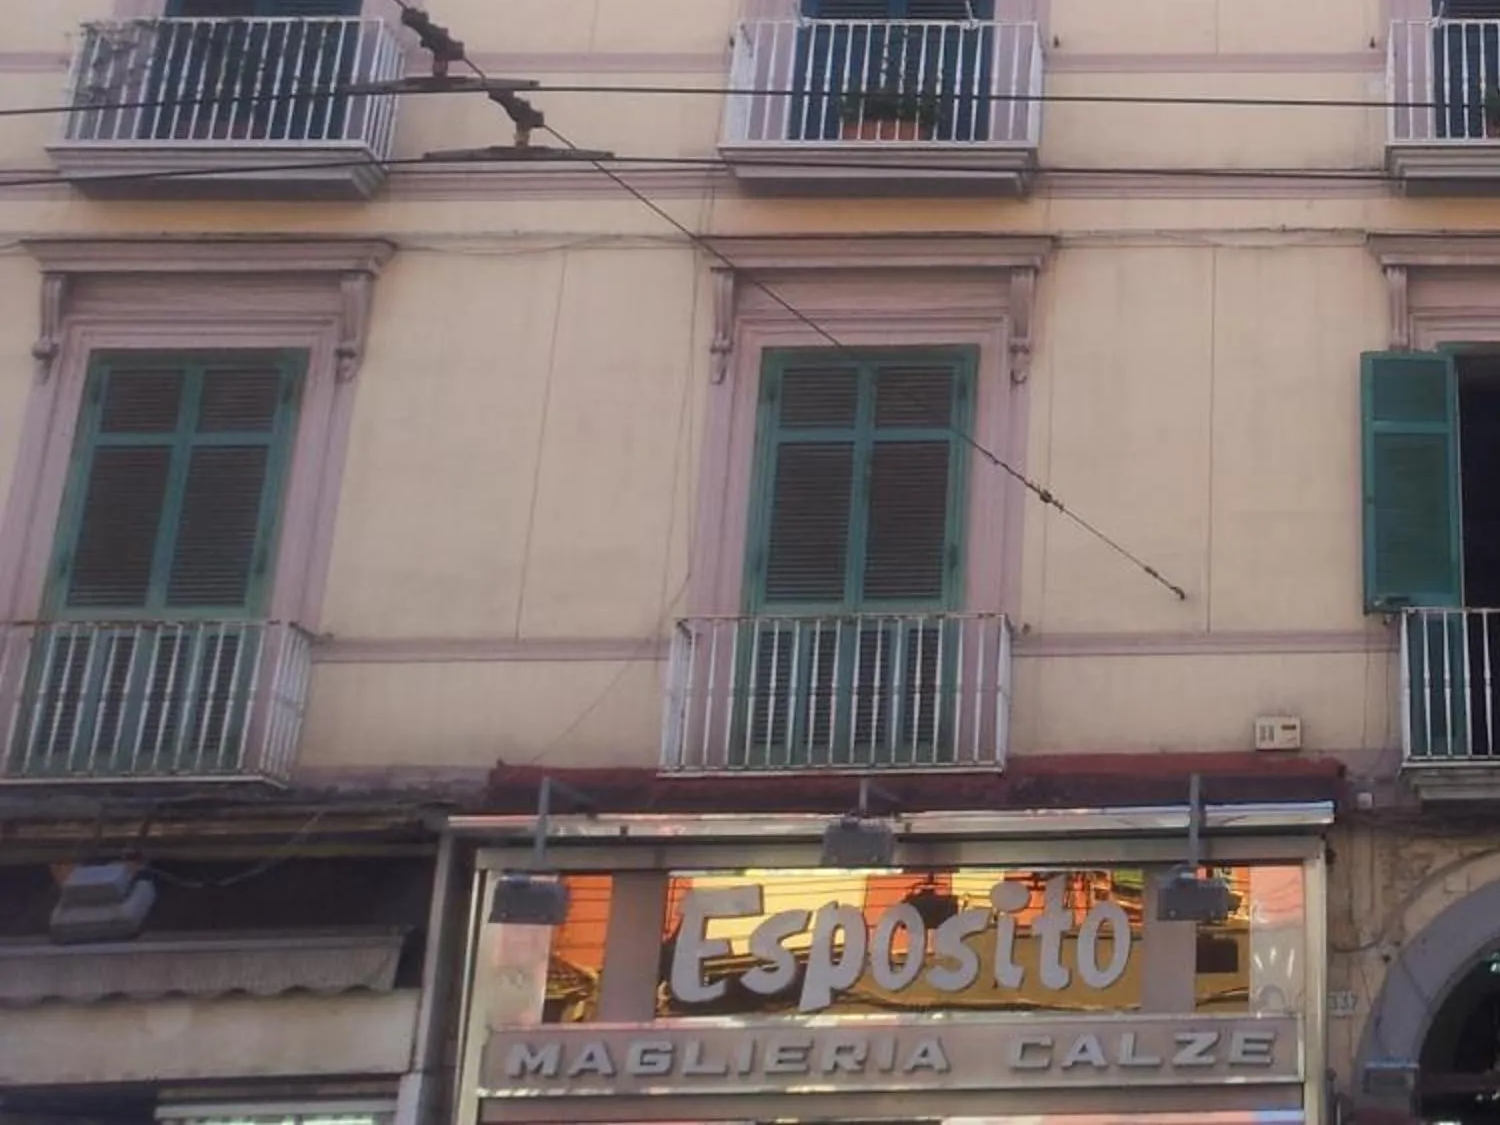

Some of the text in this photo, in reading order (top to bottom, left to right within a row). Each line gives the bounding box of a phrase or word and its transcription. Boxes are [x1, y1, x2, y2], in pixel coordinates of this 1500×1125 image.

[670, 875, 1132, 1012] Esposito
[504, 1030, 1275, 1079] MAGLIERIA CALZE
